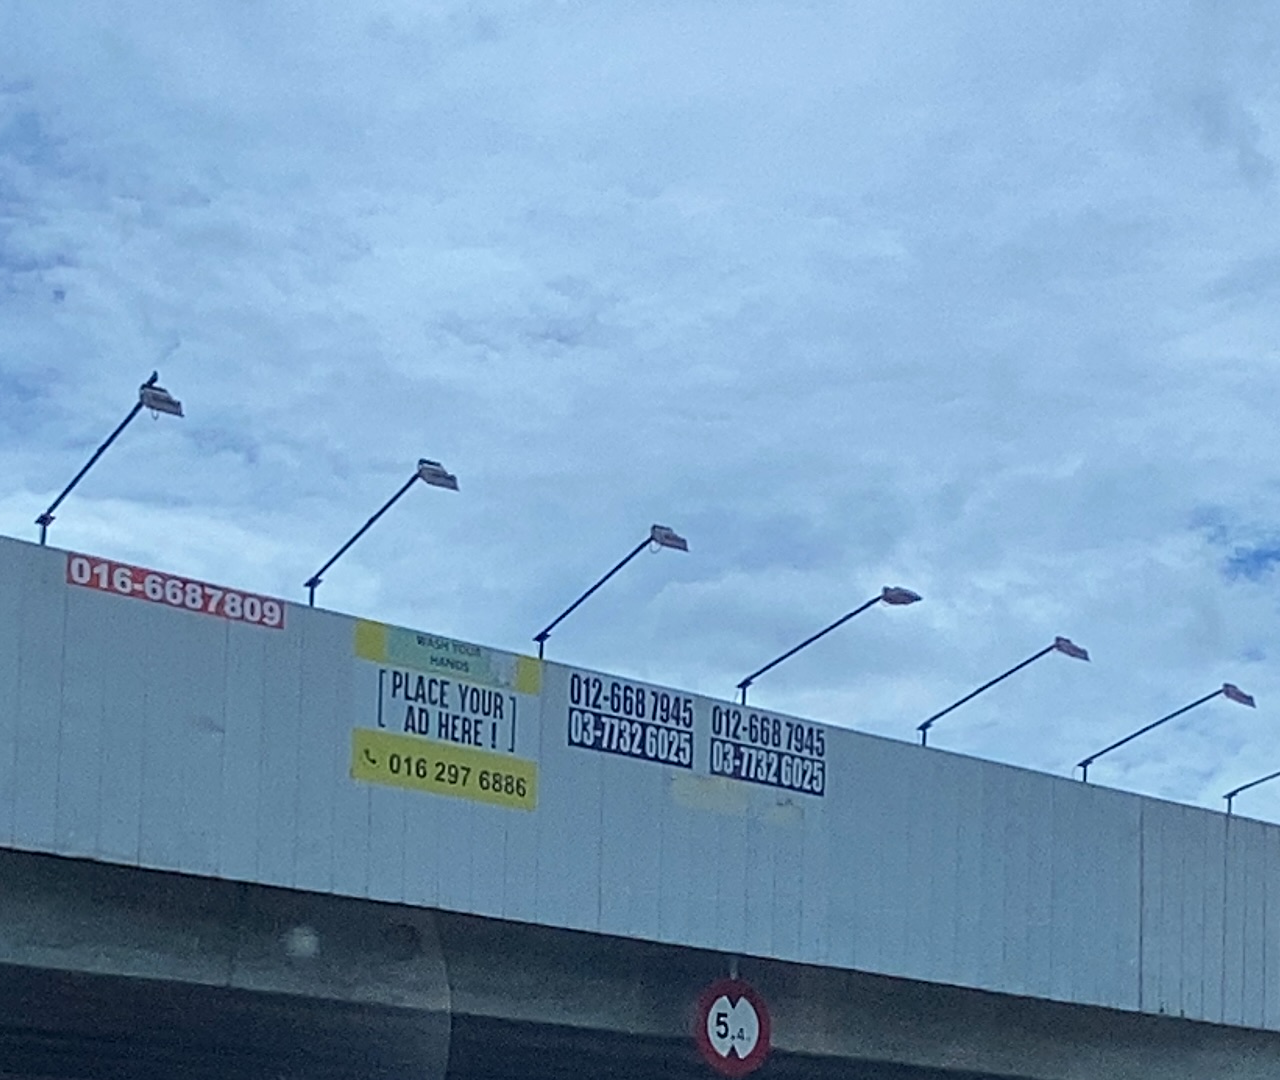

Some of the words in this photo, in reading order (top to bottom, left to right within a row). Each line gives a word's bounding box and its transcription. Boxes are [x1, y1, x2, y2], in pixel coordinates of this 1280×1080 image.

[70, 557, 282, 626] 016-6687809
[416, 635, 449, 653] WASH
[452, 643, 482, 657] YOUR
[430, 656, 469, 672] HANDS
[391, 671, 451, 708] PLACE
[458, 685, 504, 720] YOUR
[570, 673, 646, 719] 012-668
[651, 691, 693, 729] 7945
[404, 705, 430, 735] AD
[438, 711, 483, 747] HERE
[570, 710, 643, 755] 03-7732
[645, 728, 692, 766] 6025
[712, 705, 782, 747] 012-668
[786, 722, 826, 758] 7945
[389, 753, 427, 779] 016
[435, 762, 471, 787] 297
[479, 770, 527, 798] 6886
[712, 740, 779, 784] 03-7732
[781, 756, 824, 793] 6025
